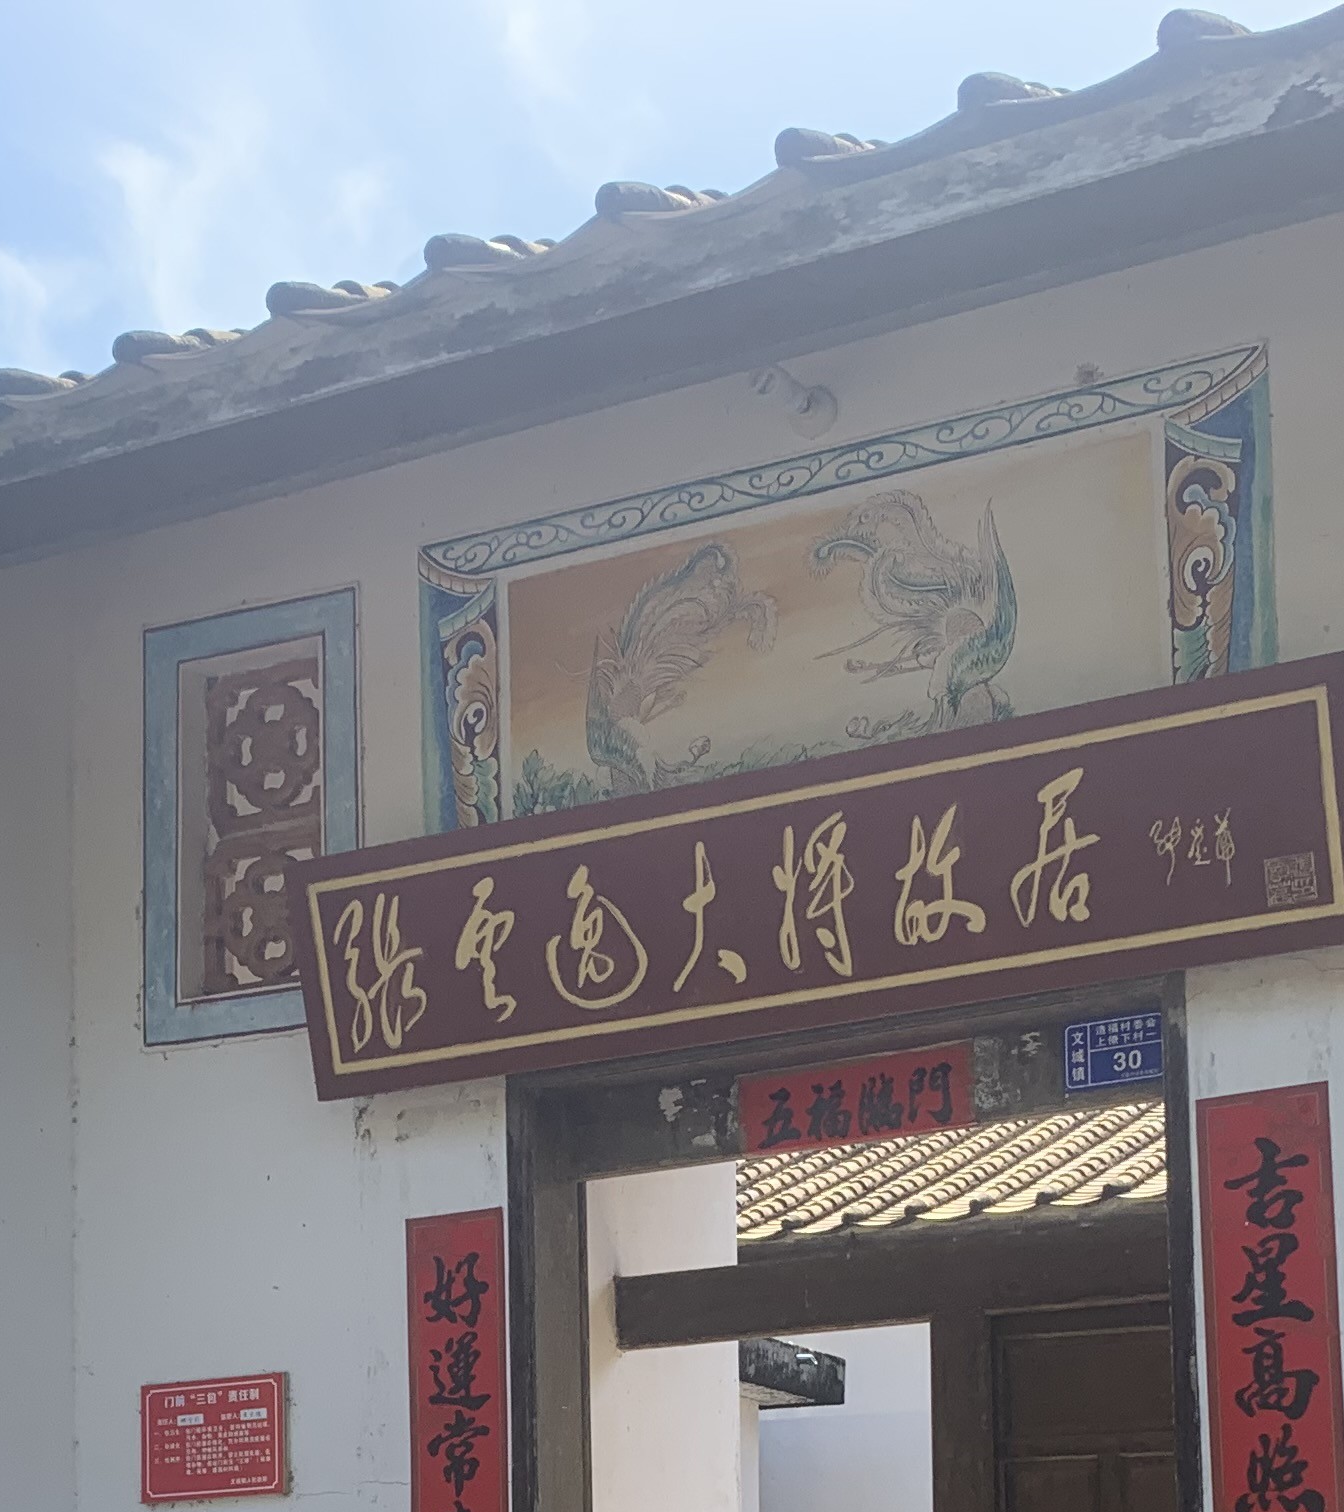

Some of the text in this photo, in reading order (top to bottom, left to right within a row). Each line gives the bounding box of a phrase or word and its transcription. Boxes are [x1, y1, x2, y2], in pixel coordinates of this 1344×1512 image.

[1071, 1031, 1085, 1082] 文城镇
[1113, 1049, 1142, 1072] 30
